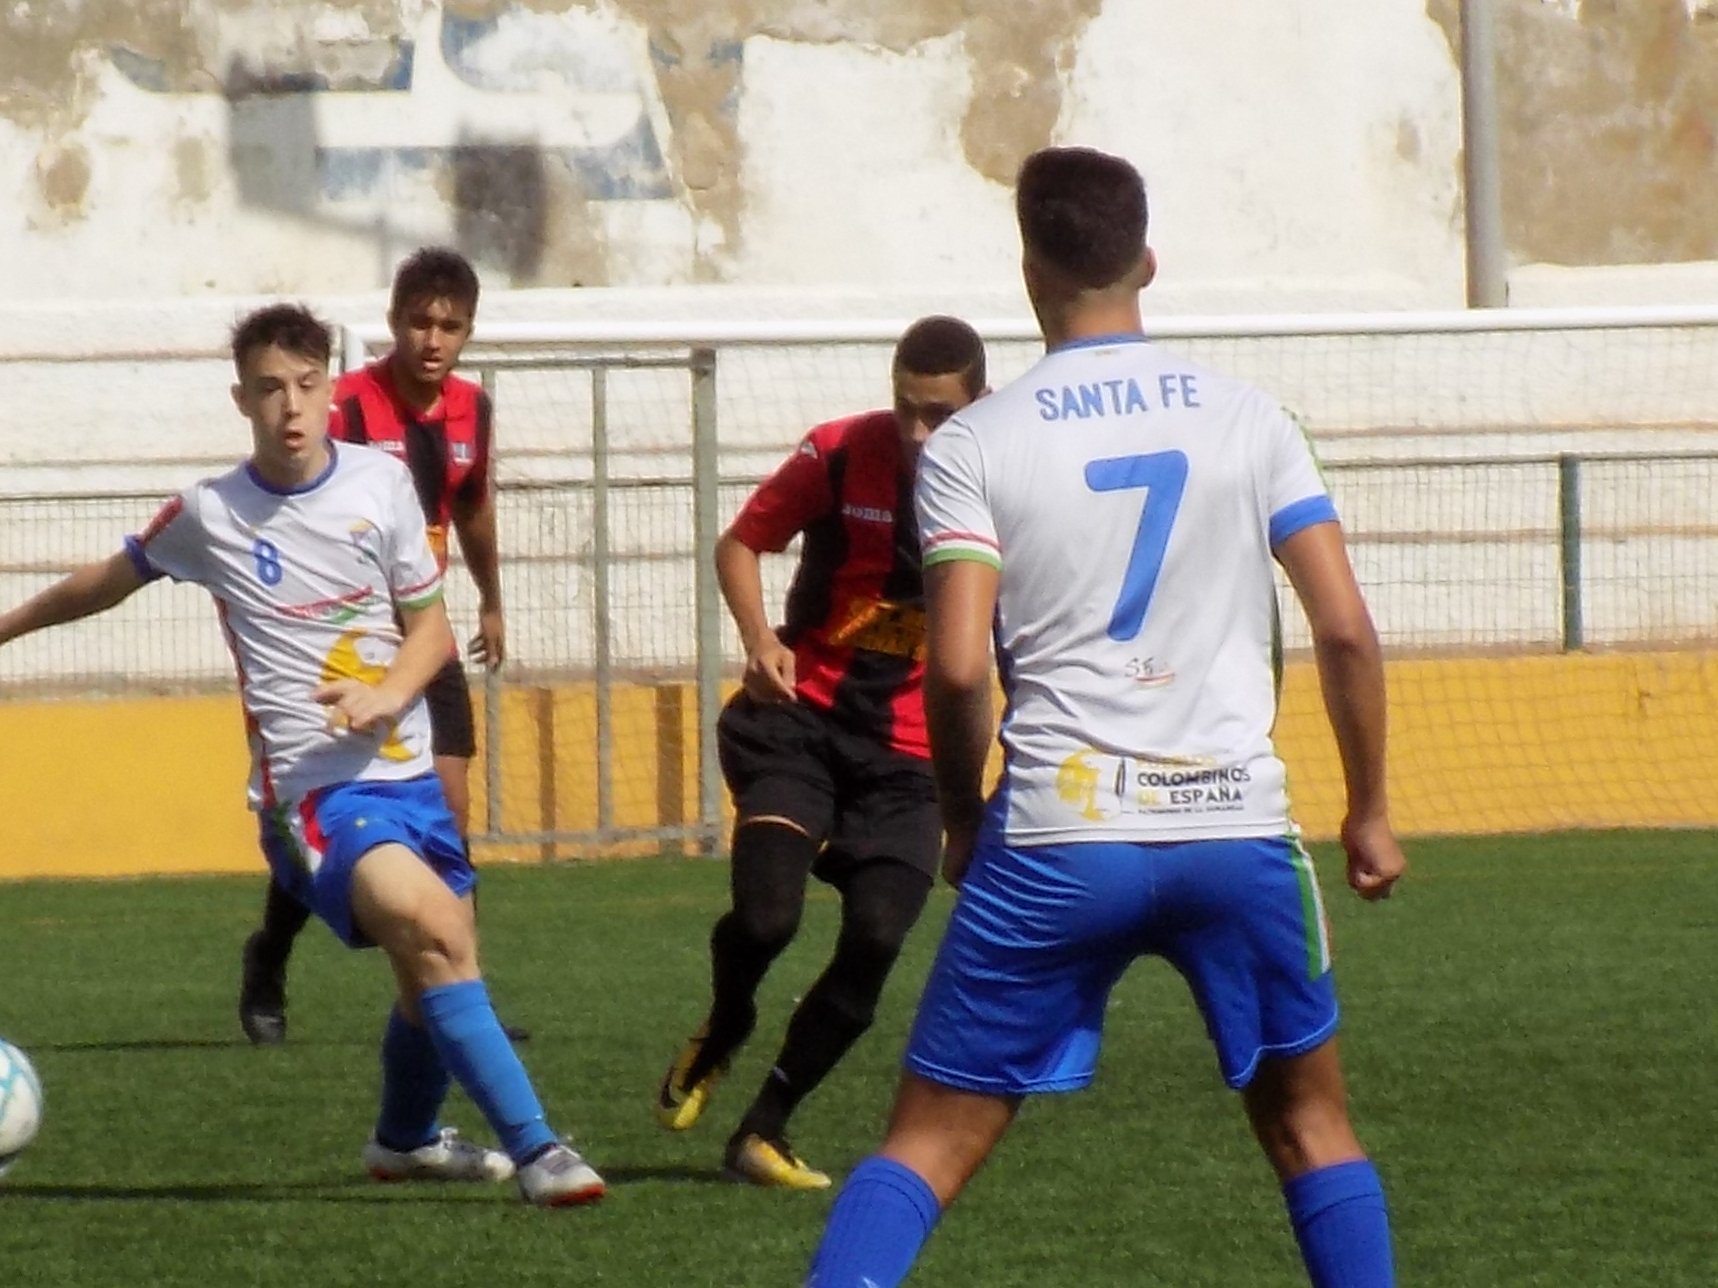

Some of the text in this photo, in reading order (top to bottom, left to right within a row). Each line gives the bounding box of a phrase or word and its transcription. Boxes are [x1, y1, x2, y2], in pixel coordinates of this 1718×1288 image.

[1034, 372, 1201, 421] SANTA FE
[252, 537, 283, 586] 8
[1084, 448, 1190, 642] 7
[1137, 767, 1251, 787] COLOMBINOS
[1169, 785, 1244, 805] ESPAÑA
